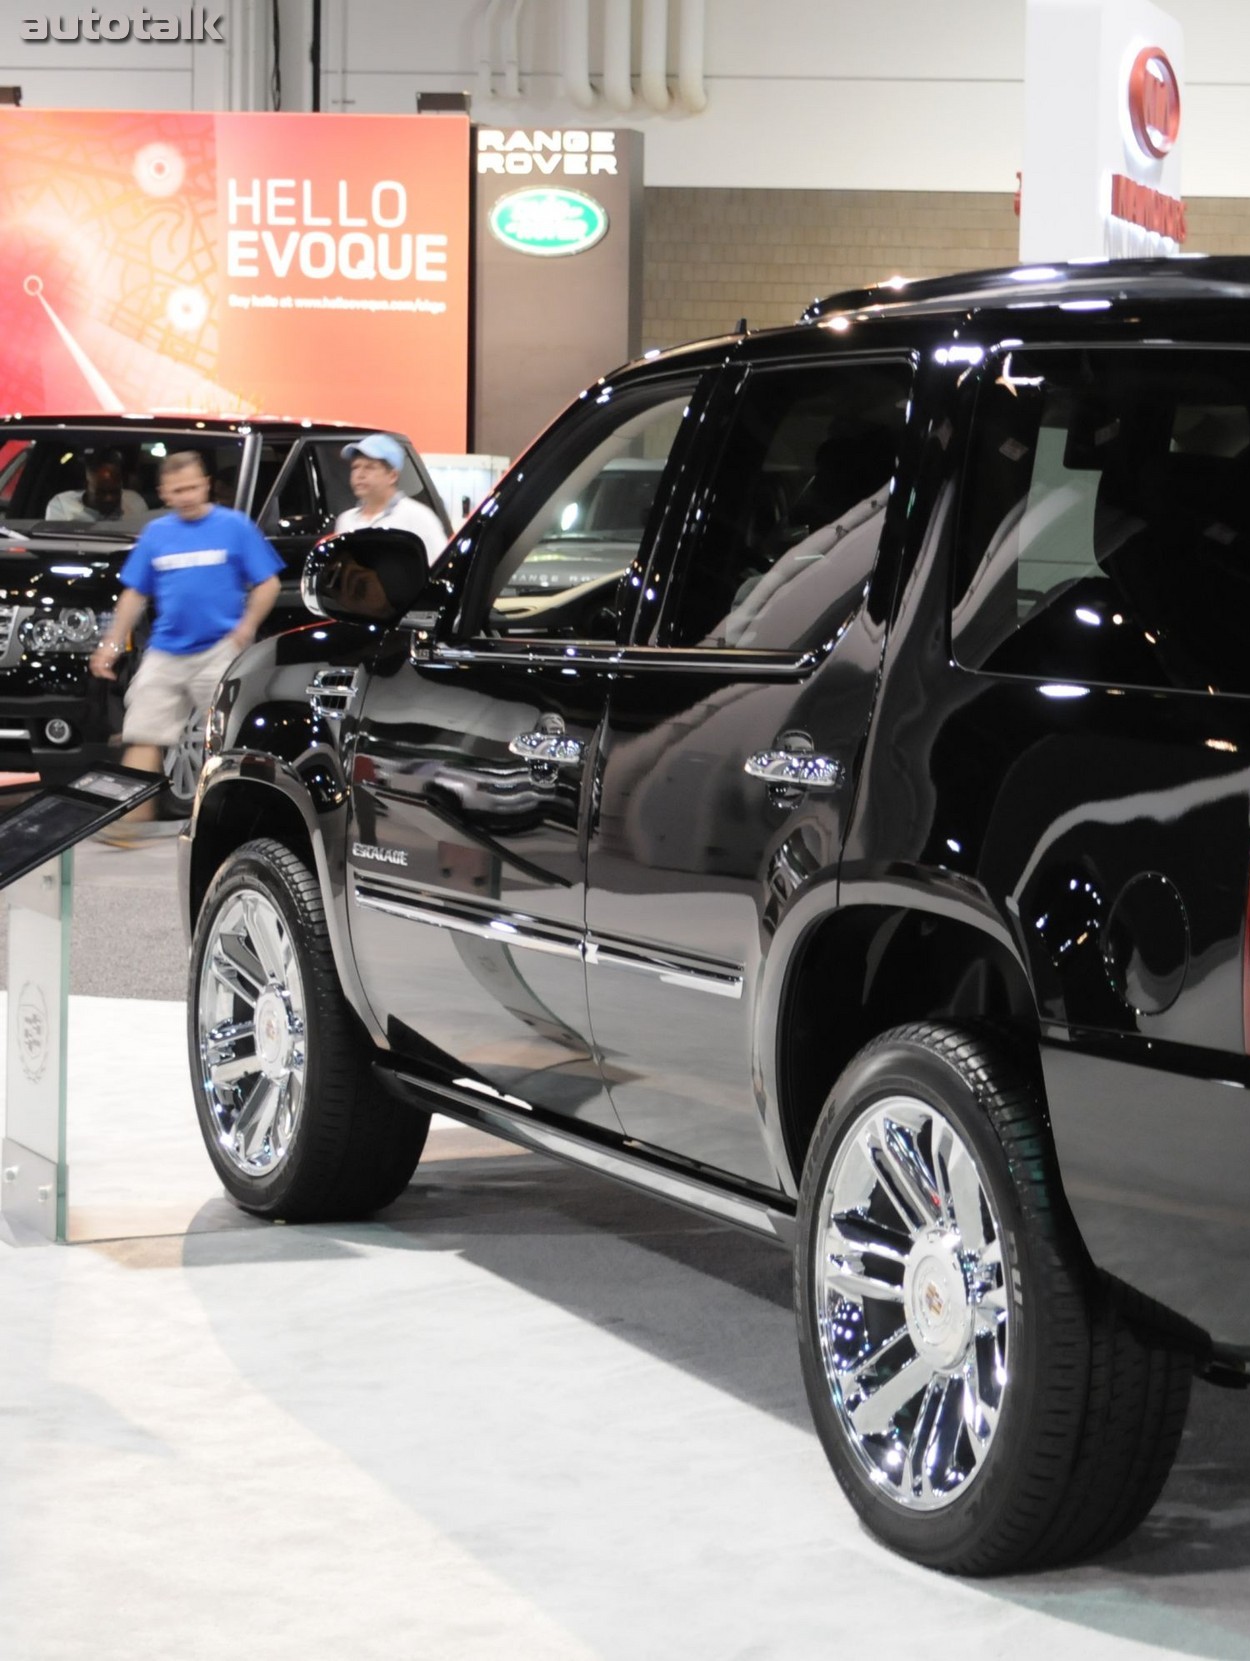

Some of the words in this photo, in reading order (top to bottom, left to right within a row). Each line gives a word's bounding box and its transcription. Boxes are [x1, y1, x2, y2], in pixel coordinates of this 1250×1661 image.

[477, 130, 615, 152] RANGE
[477, 152, 618, 175] ROVER
[227, 178, 408, 228] HELLO
[227, 230, 448, 282] EVOQUE
[352, 841, 409, 867] ESCALADE
